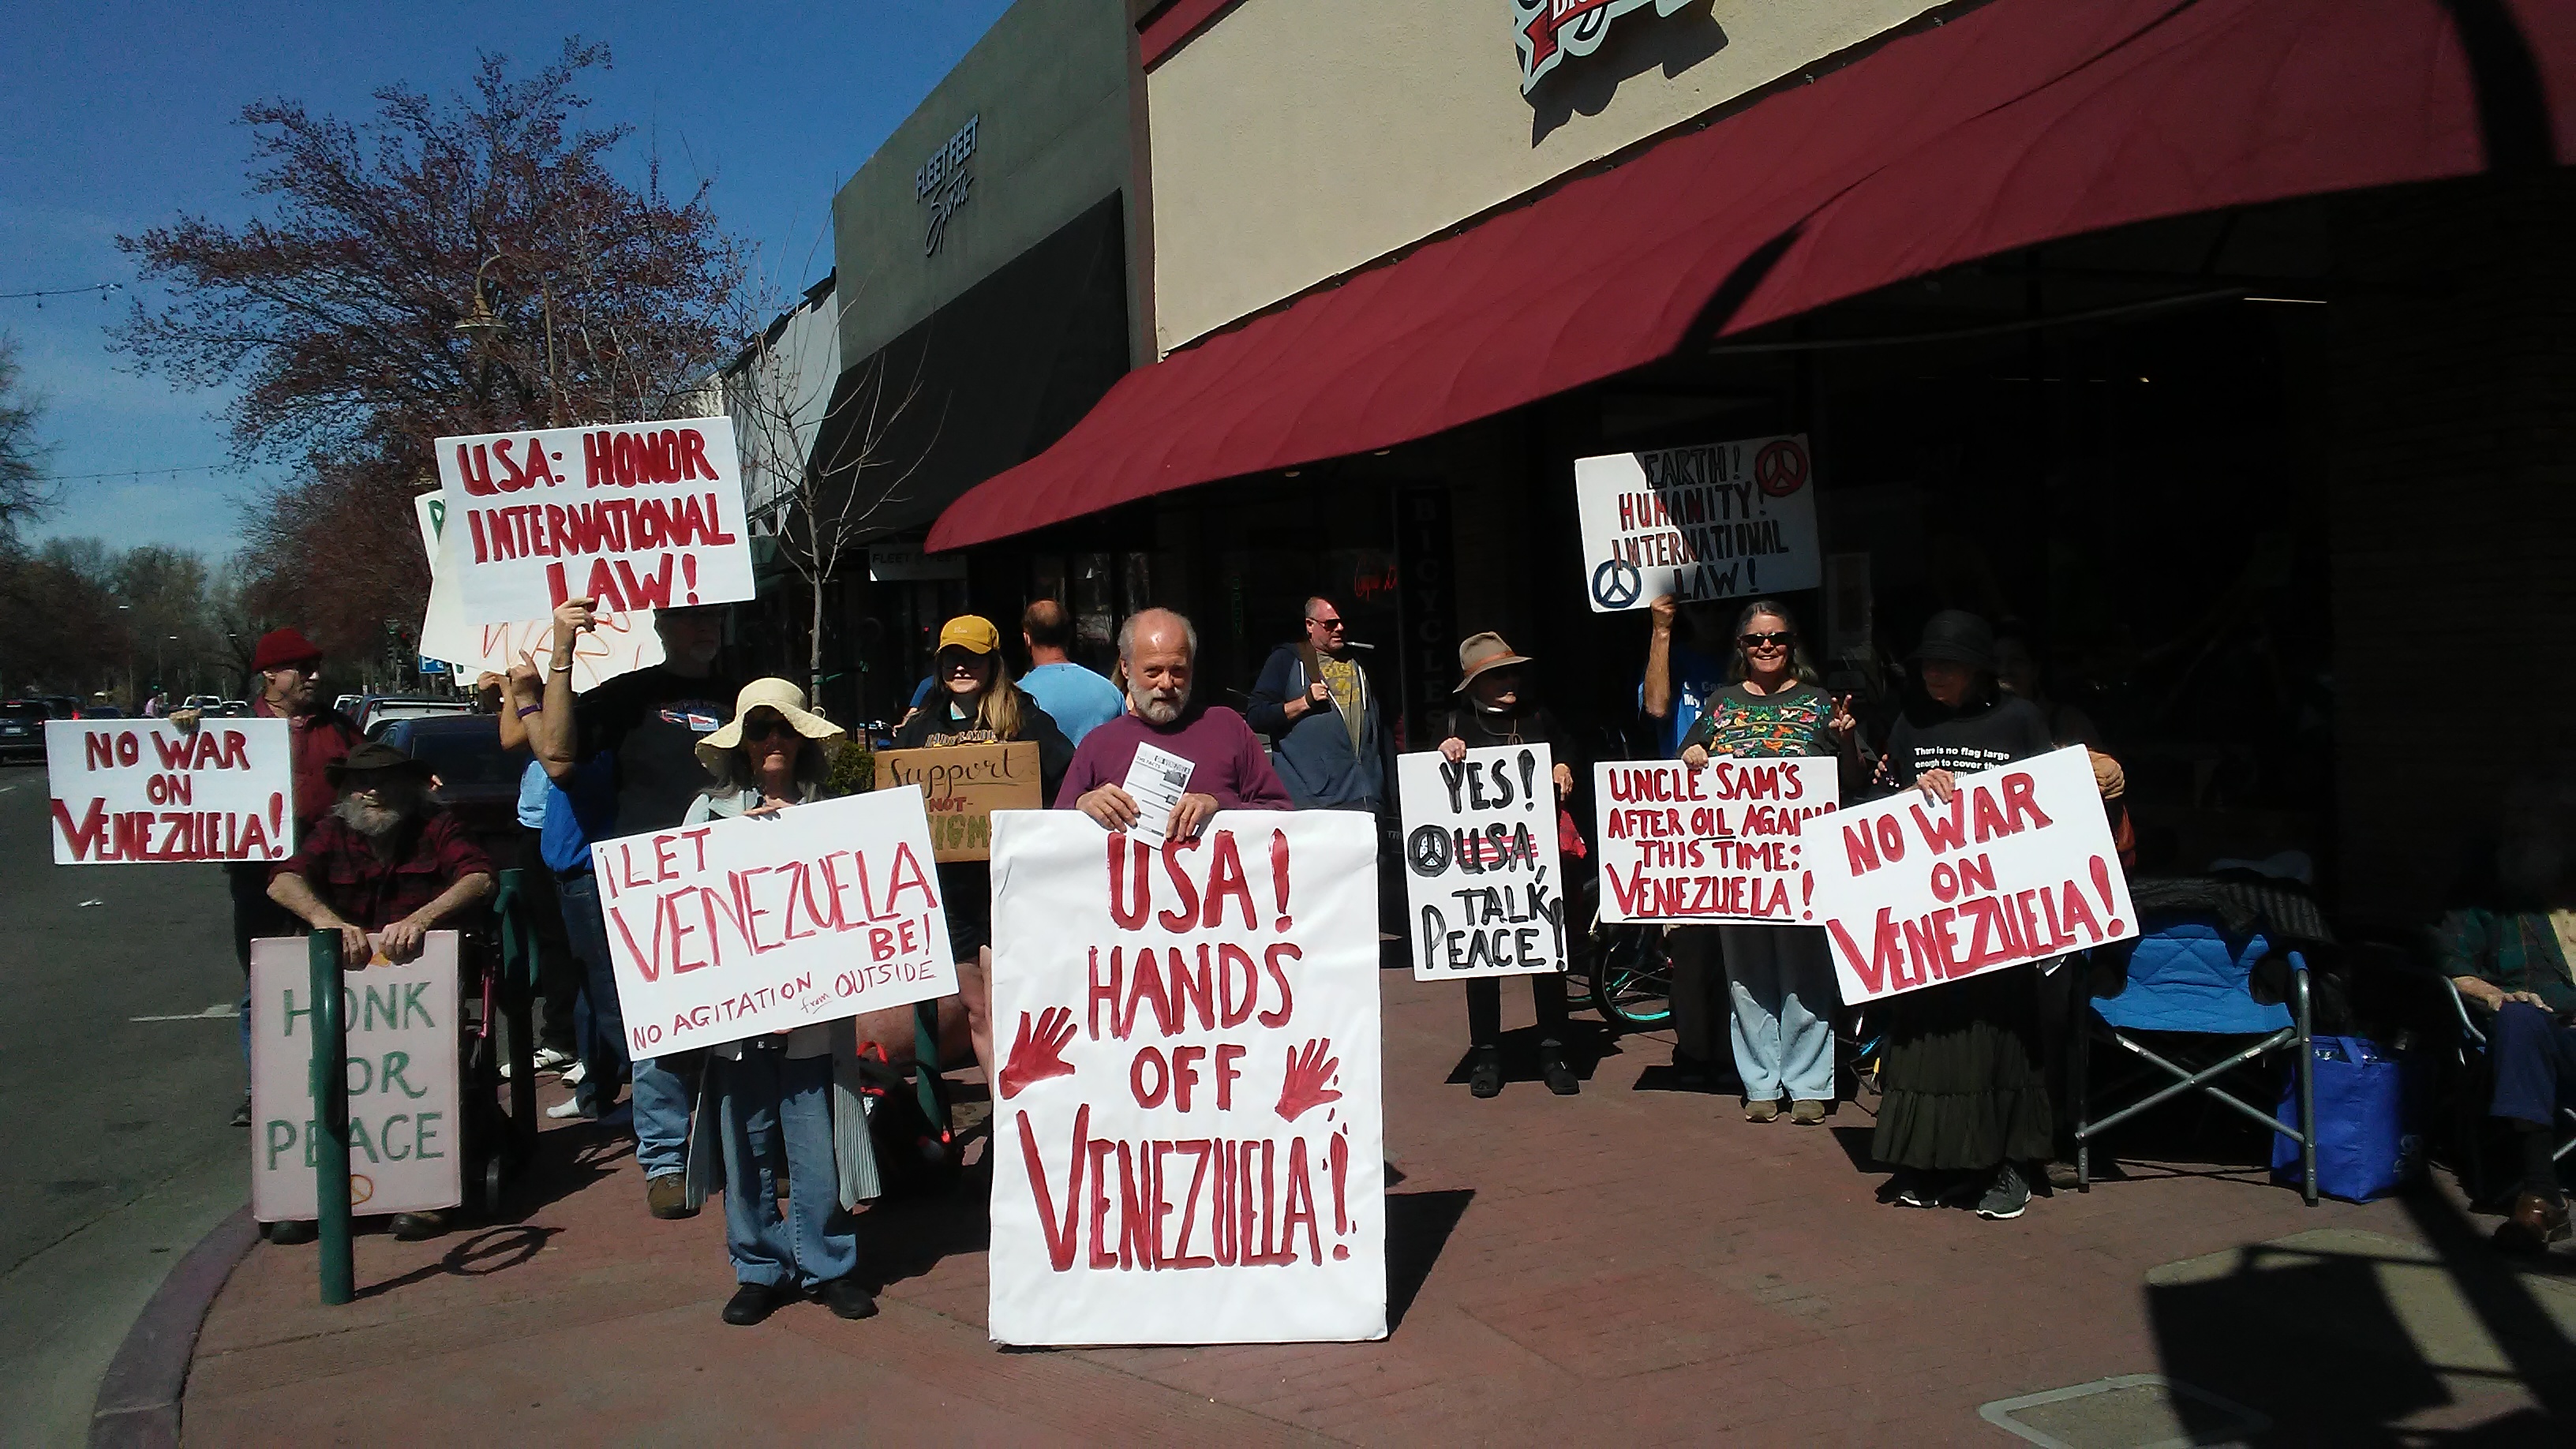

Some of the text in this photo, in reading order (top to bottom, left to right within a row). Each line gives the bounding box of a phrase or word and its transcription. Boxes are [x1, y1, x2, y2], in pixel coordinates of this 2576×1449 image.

[915, 114, 979, 204] FLEET FEET
[456, 429, 720, 496] USA: HONOR
[1644, 445, 1741, 490] EARTH!
[467, 492, 736, 565] INTERNATIONAL
[1618, 480, 1767, 532] HUMANITY!
[872, 552, 912, 564] FLEET
[1611, 519, 1789, 571] INTERNATIONAL
[546, 553, 699, 614] LAW!
[1672, 556, 1760, 601] LAW!
[84, 730, 251, 771] NO WAR
[891, 748, 1024, 799] Support
[1914, 747, 1935, 755] There
[1936, 746, 1944, 754] is
[1961, 747, 1982, 758] flag
[1983, 749, 2010, 760] large
[1915, 758, 1939, 768] enough
[1941, 758, 1951, 767] to
[1953, 760, 1982, 769] cover
[147, 773, 192, 807] ON
[1438, 749, 1536, 814] YES!
[1608, 762, 1803, 803] UNCLE SAM'S
[51, 792, 285, 862] VENEZUELA!
[927, 814, 989, 851] IGM
[1608, 802, 1837, 839] AFTER OIL AGAI
[1843, 772, 2054, 877] NO WAR
[1106, 827, 1293, 934] USA!
[1635, 840, 1802, 871] THIS TIME:
[1930, 852, 1997, 903] ON
[609, 841, 939, 983] VENEZUELA
[1451, 882, 1550, 927] TALK
[1605, 860, 1815, 921] VENEZUELA!
[868, 912, 932, 963] BE!
[1421, 897, 1567, 972] PEACE!
[1825, 854, 2125, 995] VENEZUELA!
[632, 960, 936, 1051] NO AGITATION from OUTSIDE
[1087, 942, 1303, 1042] HANDS
[307, 1050, 427, 1099] OR
[1129, 1043, 1249, 1113] OFF
[1015, 1103, 1351, 1272] VENEZUELA!
